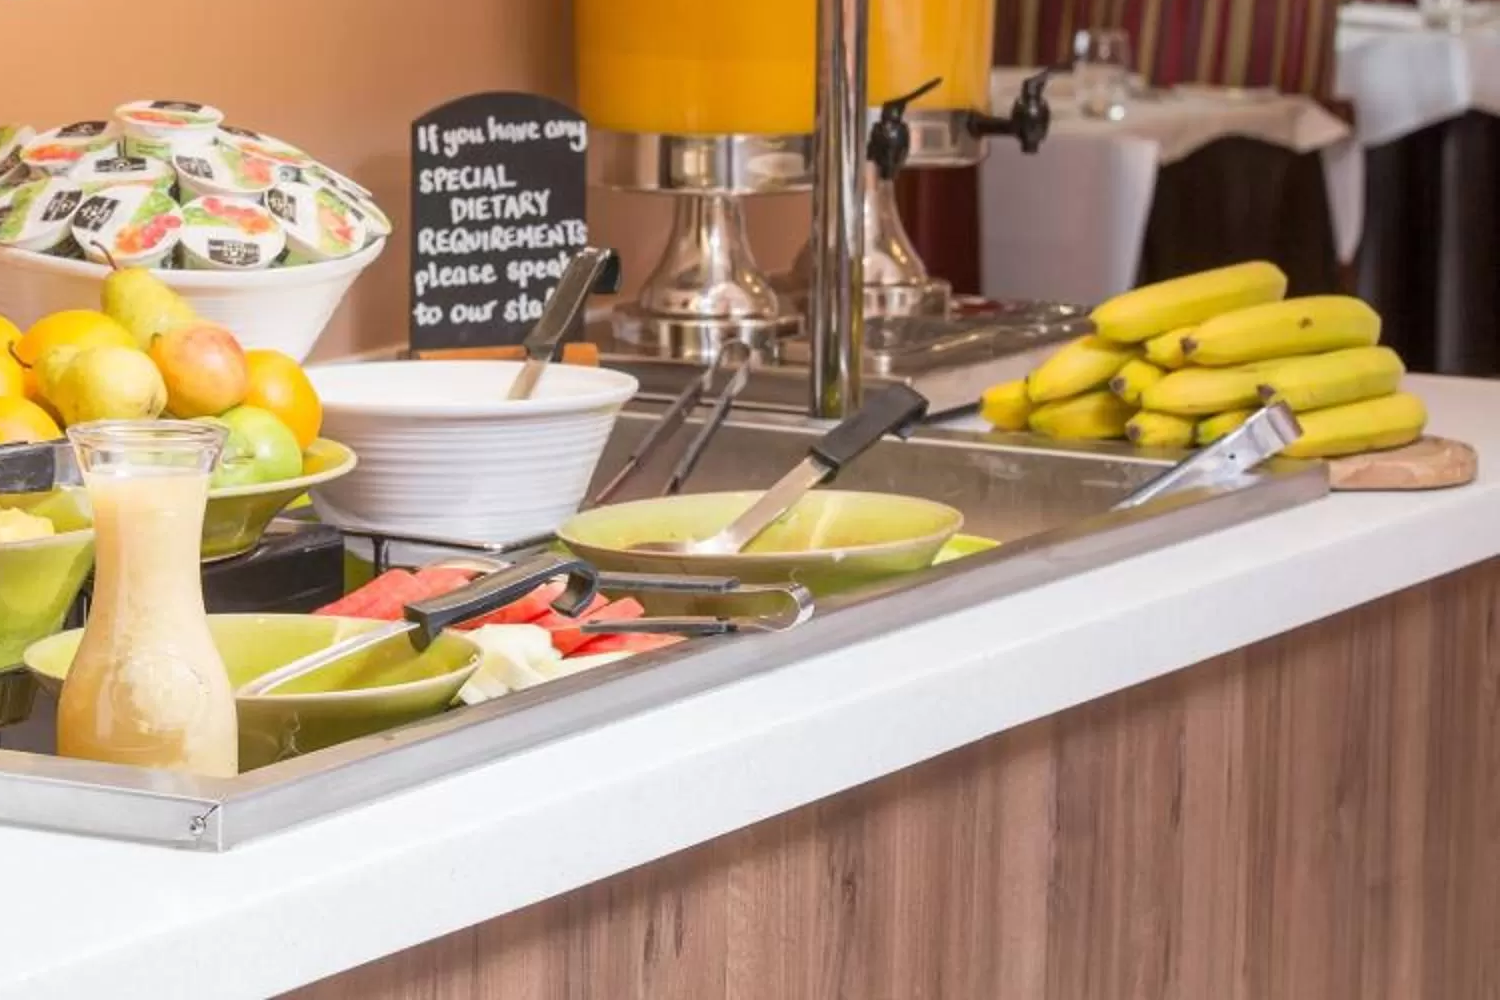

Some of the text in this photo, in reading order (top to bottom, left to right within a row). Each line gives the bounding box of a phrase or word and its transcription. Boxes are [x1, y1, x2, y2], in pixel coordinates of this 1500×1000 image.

[417, 115, 588, 158] If you have any
[419, 164, 517, 194] SPECIAL
[450, 189, 551, 225] DIETARY
[417, 219, 588, 255] REQUIREMENTS
[414, 261, 498, 297] please
[412, 286, 556, 326] to our sta
